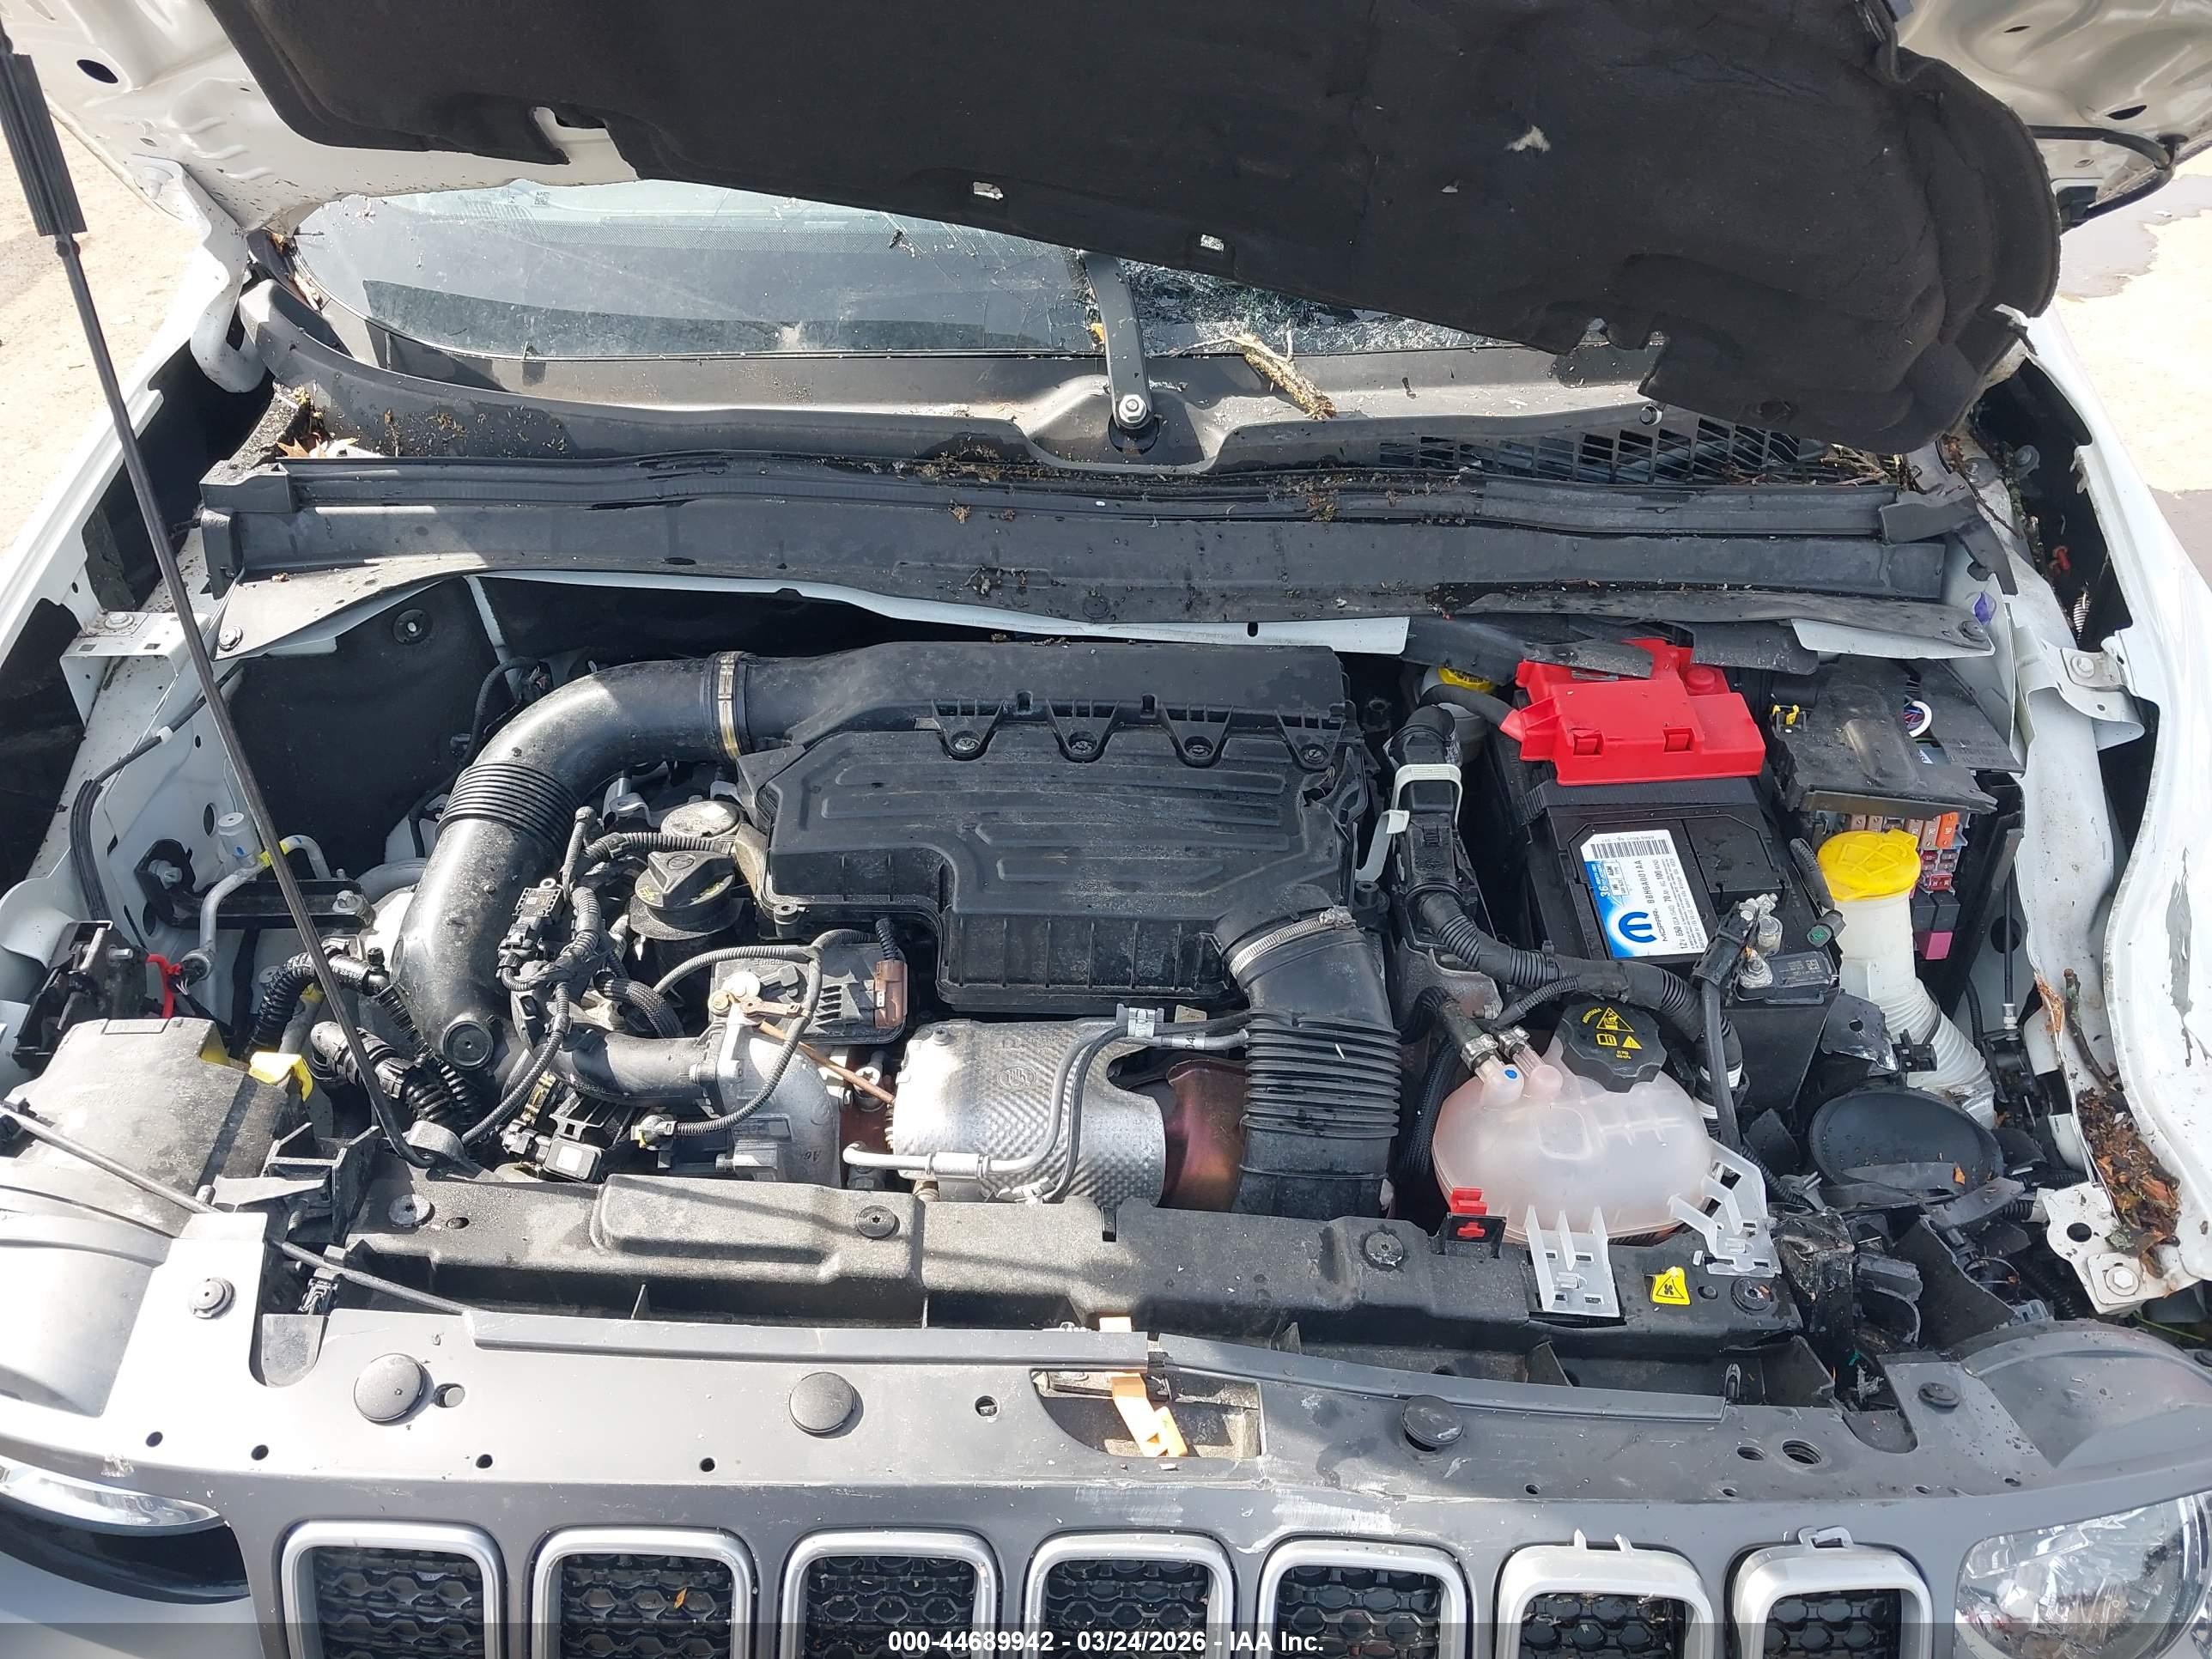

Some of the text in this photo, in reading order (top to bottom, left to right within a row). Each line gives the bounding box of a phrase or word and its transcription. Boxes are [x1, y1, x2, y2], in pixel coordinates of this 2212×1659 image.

[1654, 870, 1664, 879] 100
[1598, 885, 1610, 897] 36
[1674, 926, 1684, 937] 650
